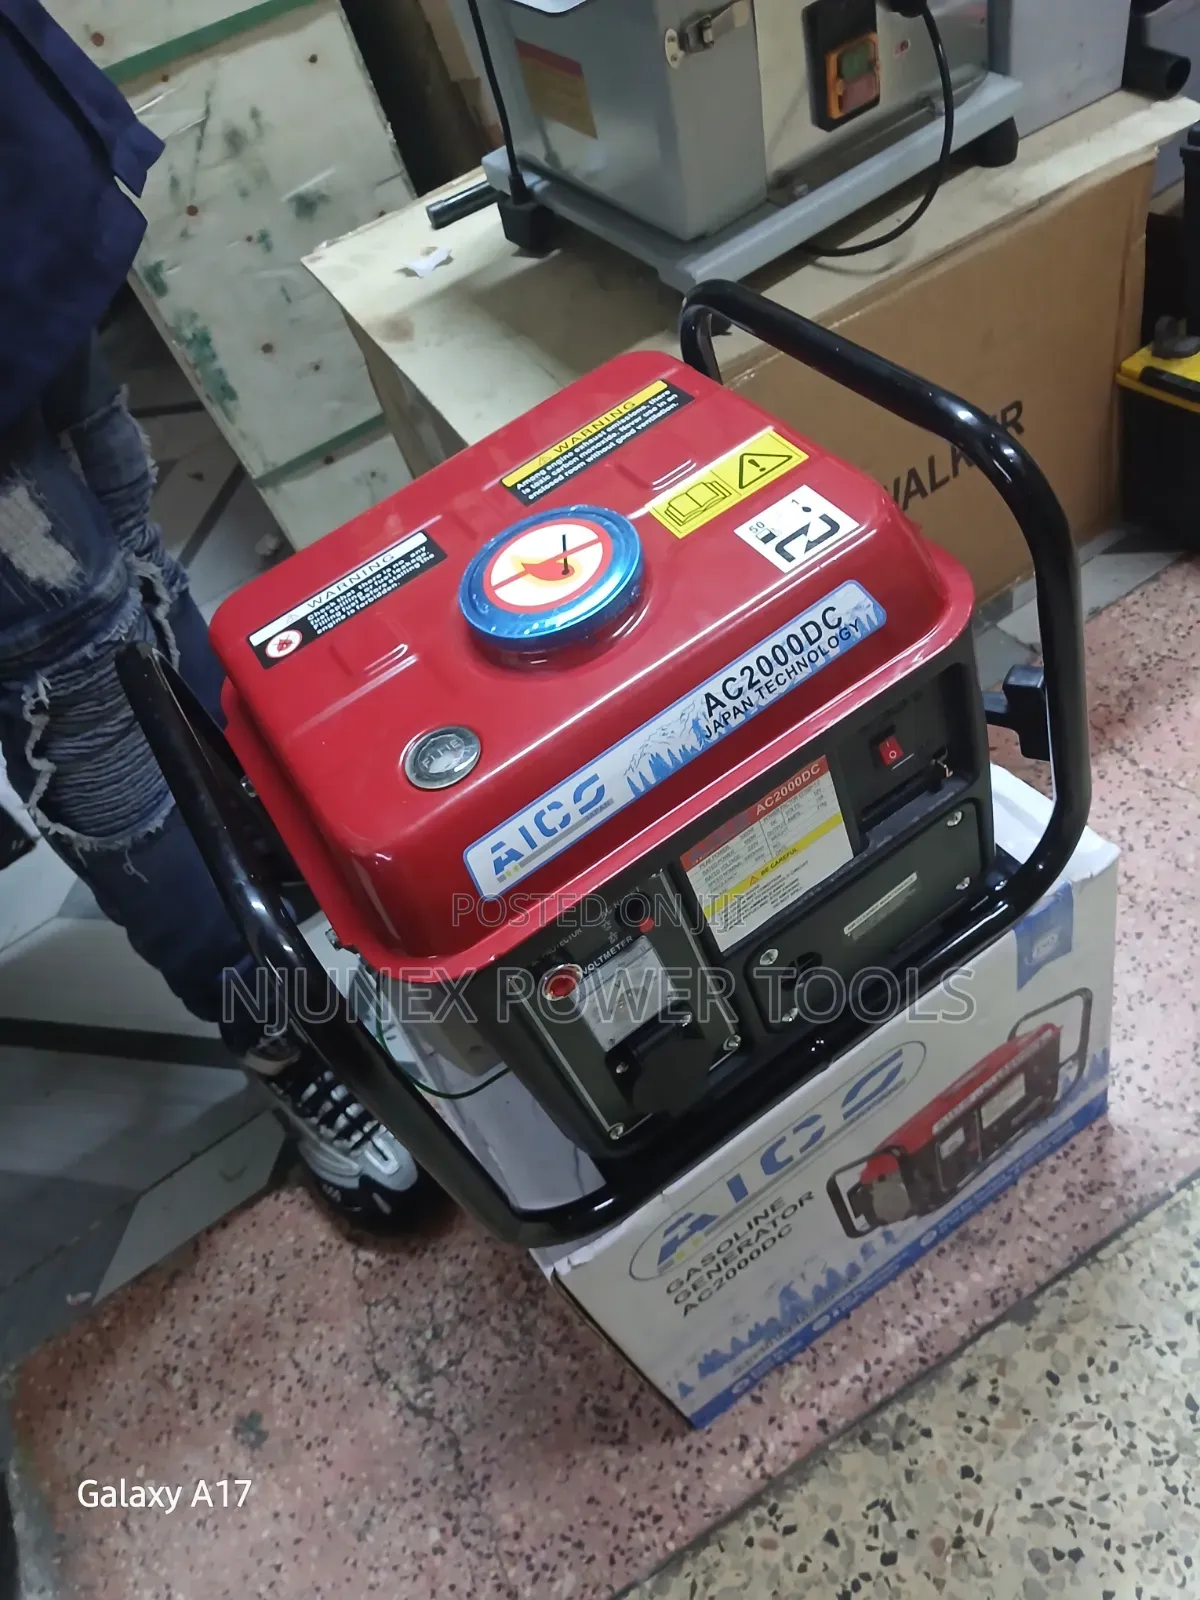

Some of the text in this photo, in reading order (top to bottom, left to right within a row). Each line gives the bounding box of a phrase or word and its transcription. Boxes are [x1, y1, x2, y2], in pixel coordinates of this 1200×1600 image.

[517, 470, 546, 489] Among
[546, 452, 573, 470] engine
[574, 431, 606, 452] exhaust
[649, 390, 670, 404] there
[552, 457, 578, 475] carbon
[619, 416, 641, 431] Never
[643, 407, 657, 416] use
[554, 402, 634, 452] WARNING
[529, 475, 564, 499] enclosed
[564, 462, 585, 476] room
[586, 442, 615, 462] without
[616, 428, 636, 444] good
[749, 521, 765, 533] 50
[308, 556, 393, 607] WARNING
[337, 590, 355, 602] that
[358, 574, 381, 589] there
[393, 560, 404, 568] no
[410, 546, 425, 557] any
[419, 554, 434, 563] the
[702, 619, 861, 741] JAPAN TECHNOLOGY
[704, 606, 844, 718] AC2000DC
[756, 763, 821, 816] AC2000DC
[760, 867, 771, 877] BE
[770, 848, 799, 870] CAREFUL
[583, 935, 633, 975] VOLTMETER
[666, 1196, 787, 1294] GASOLINE
[674, 1190, 815, 1305] GENERATOR
[682, 1223, 793, 1317] AC2000DC
